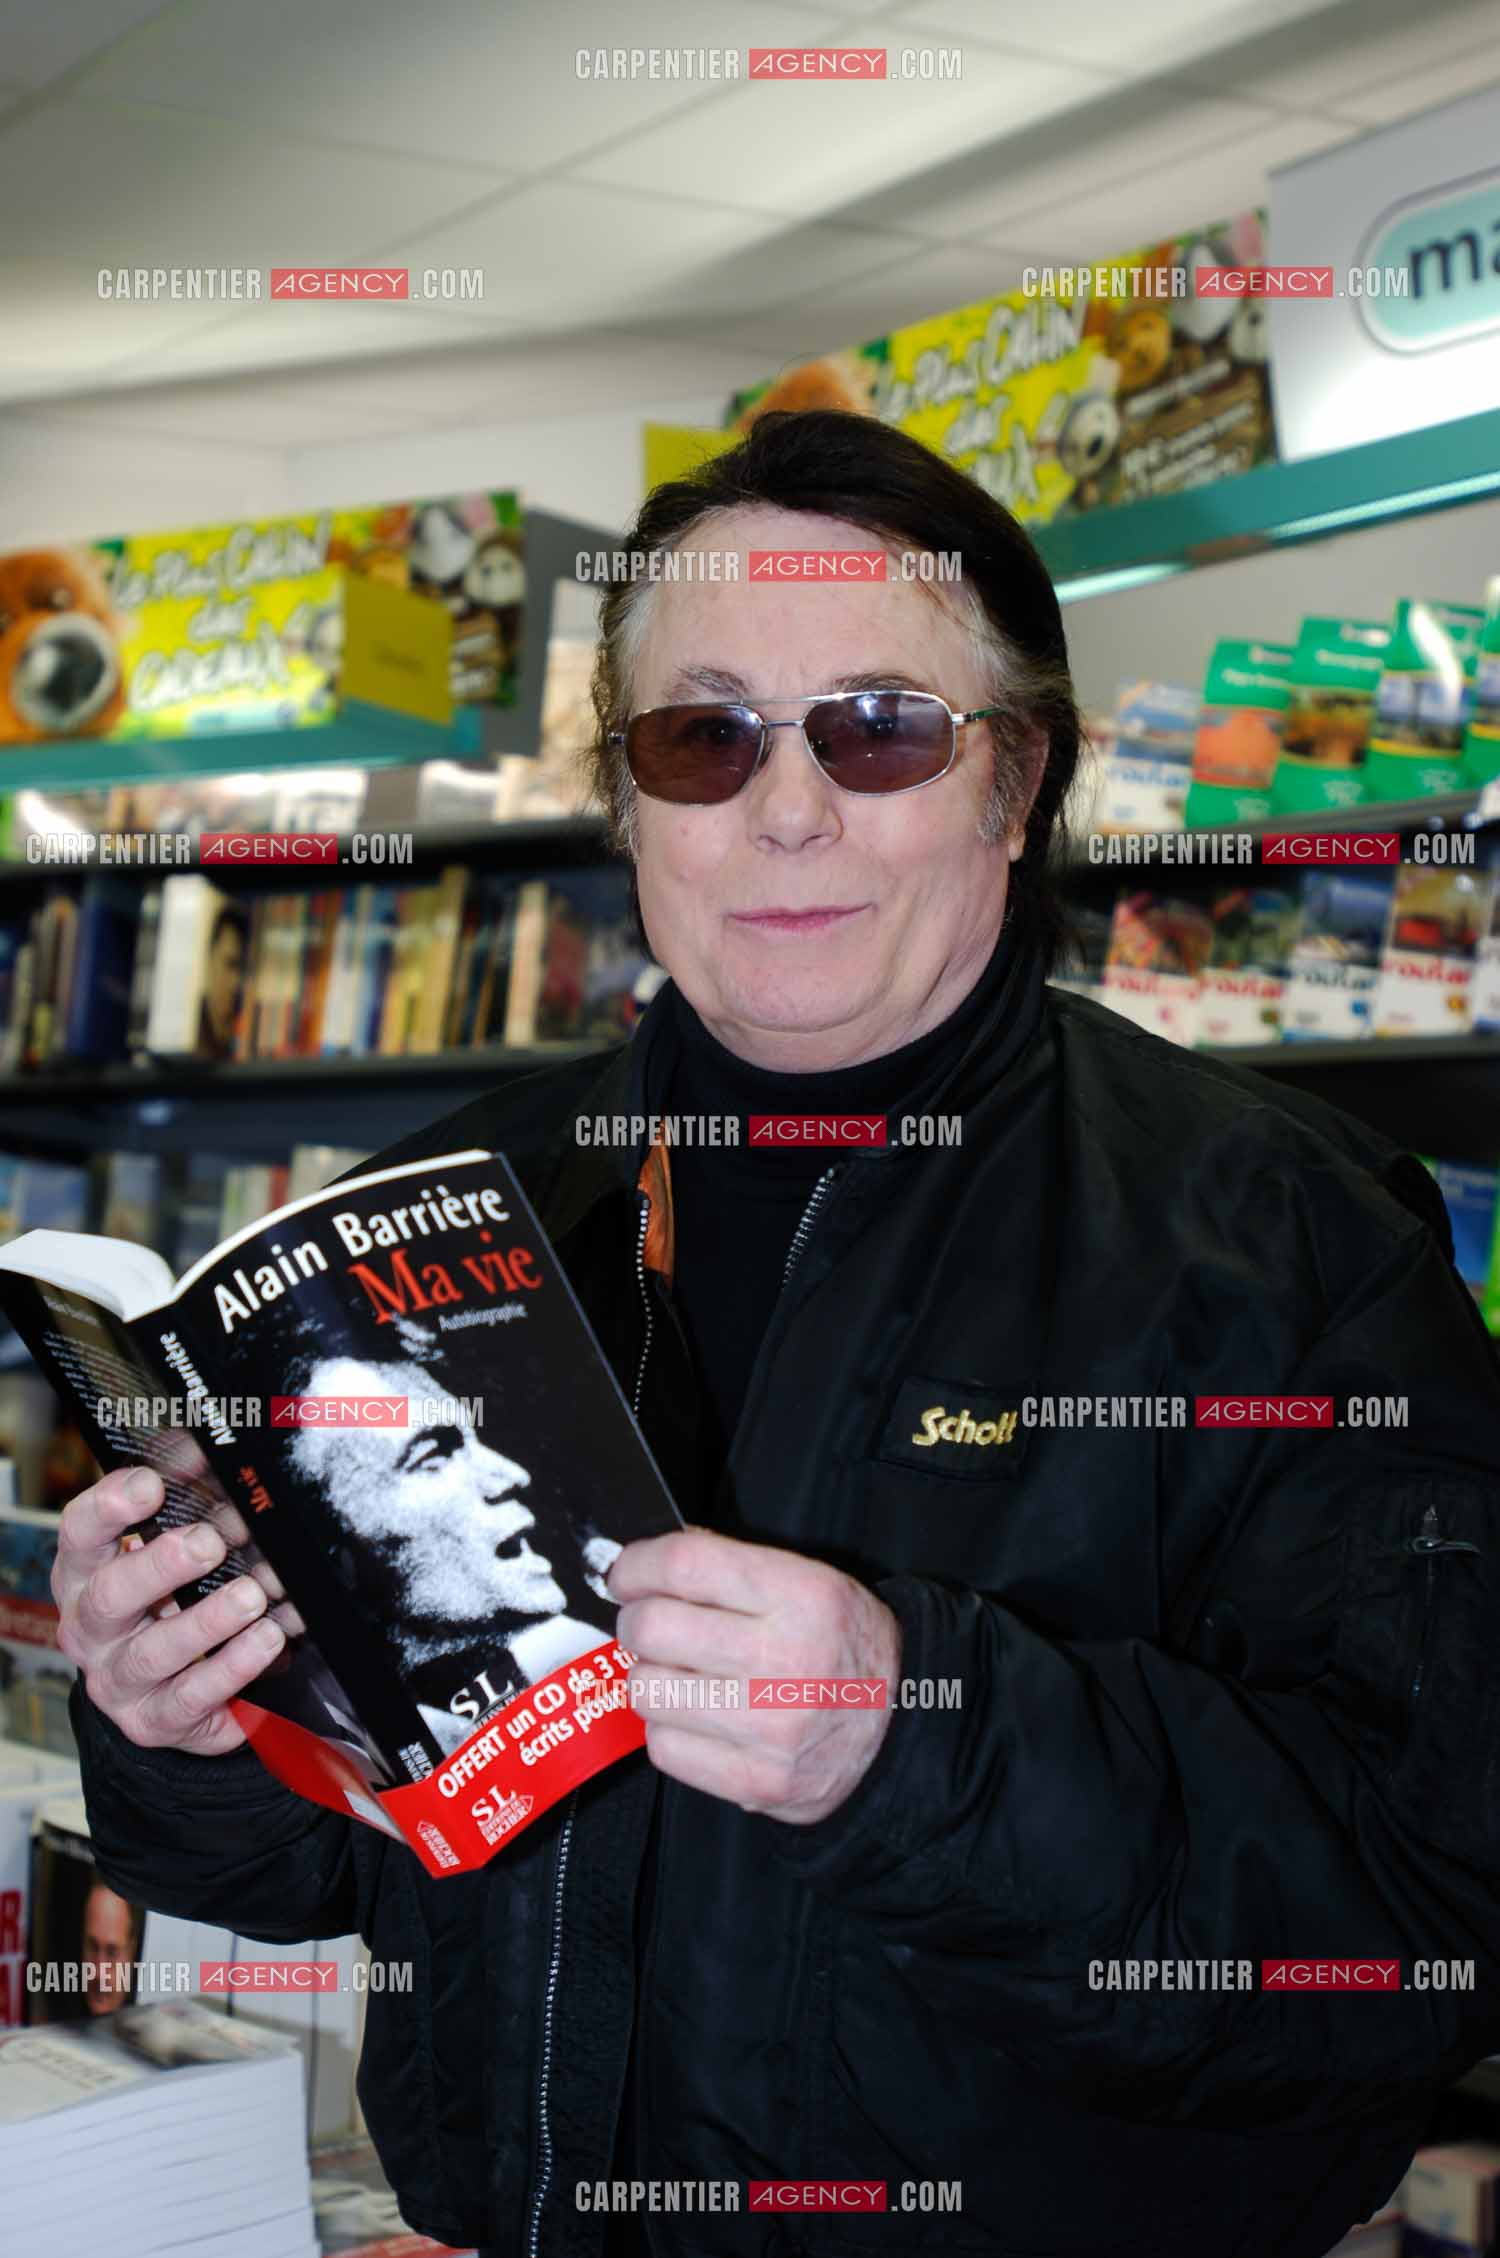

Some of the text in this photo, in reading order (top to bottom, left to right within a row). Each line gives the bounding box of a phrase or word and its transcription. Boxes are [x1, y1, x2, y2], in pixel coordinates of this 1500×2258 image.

[214, 1185, 510, 1334] Alain Barrière
[349, 1229, 543, 1325] Ma vie
[438, 1726, 507, 1798] OFFERT
[506, 1708, 536, 1739] un
[533, 1683, 567, 1715] CD
[568, 1667, 596, 1694] de
[593, 1655, 614, 1679] 3
[519, 1716, 575, 1767] écrits
